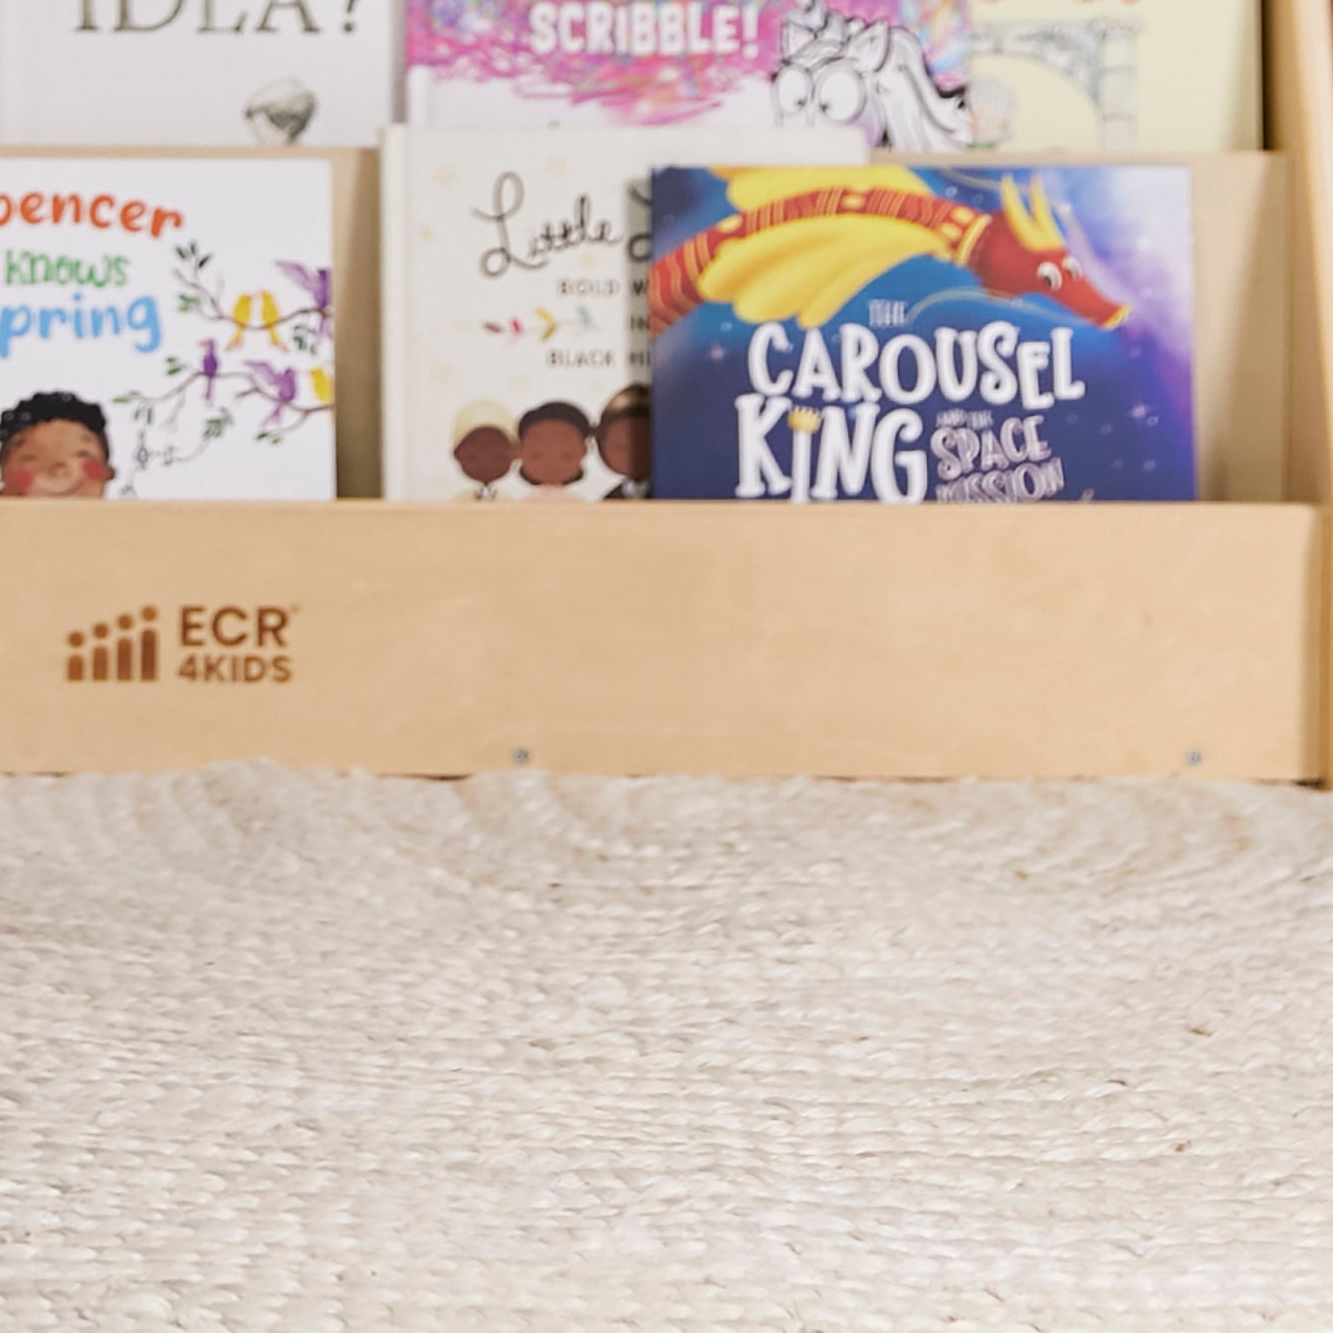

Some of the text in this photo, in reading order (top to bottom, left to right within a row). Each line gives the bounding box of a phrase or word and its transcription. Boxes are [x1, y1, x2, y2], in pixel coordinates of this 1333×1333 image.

[528, 1, 761, 59] SCRIBBLE!
[470, 170, 625, 279] Little
[557, 278, 620, 295] BOLD
[868, 299, 908, 327] THE
[547, 350, 614, 368] BLACK
[746, 319, 1087, 410] CAROUSEL
[929, 413, 1053, 481] SPACE
[180, 605, 290, 648] ECR
[176, 654, 294, 684] 4KIDS
